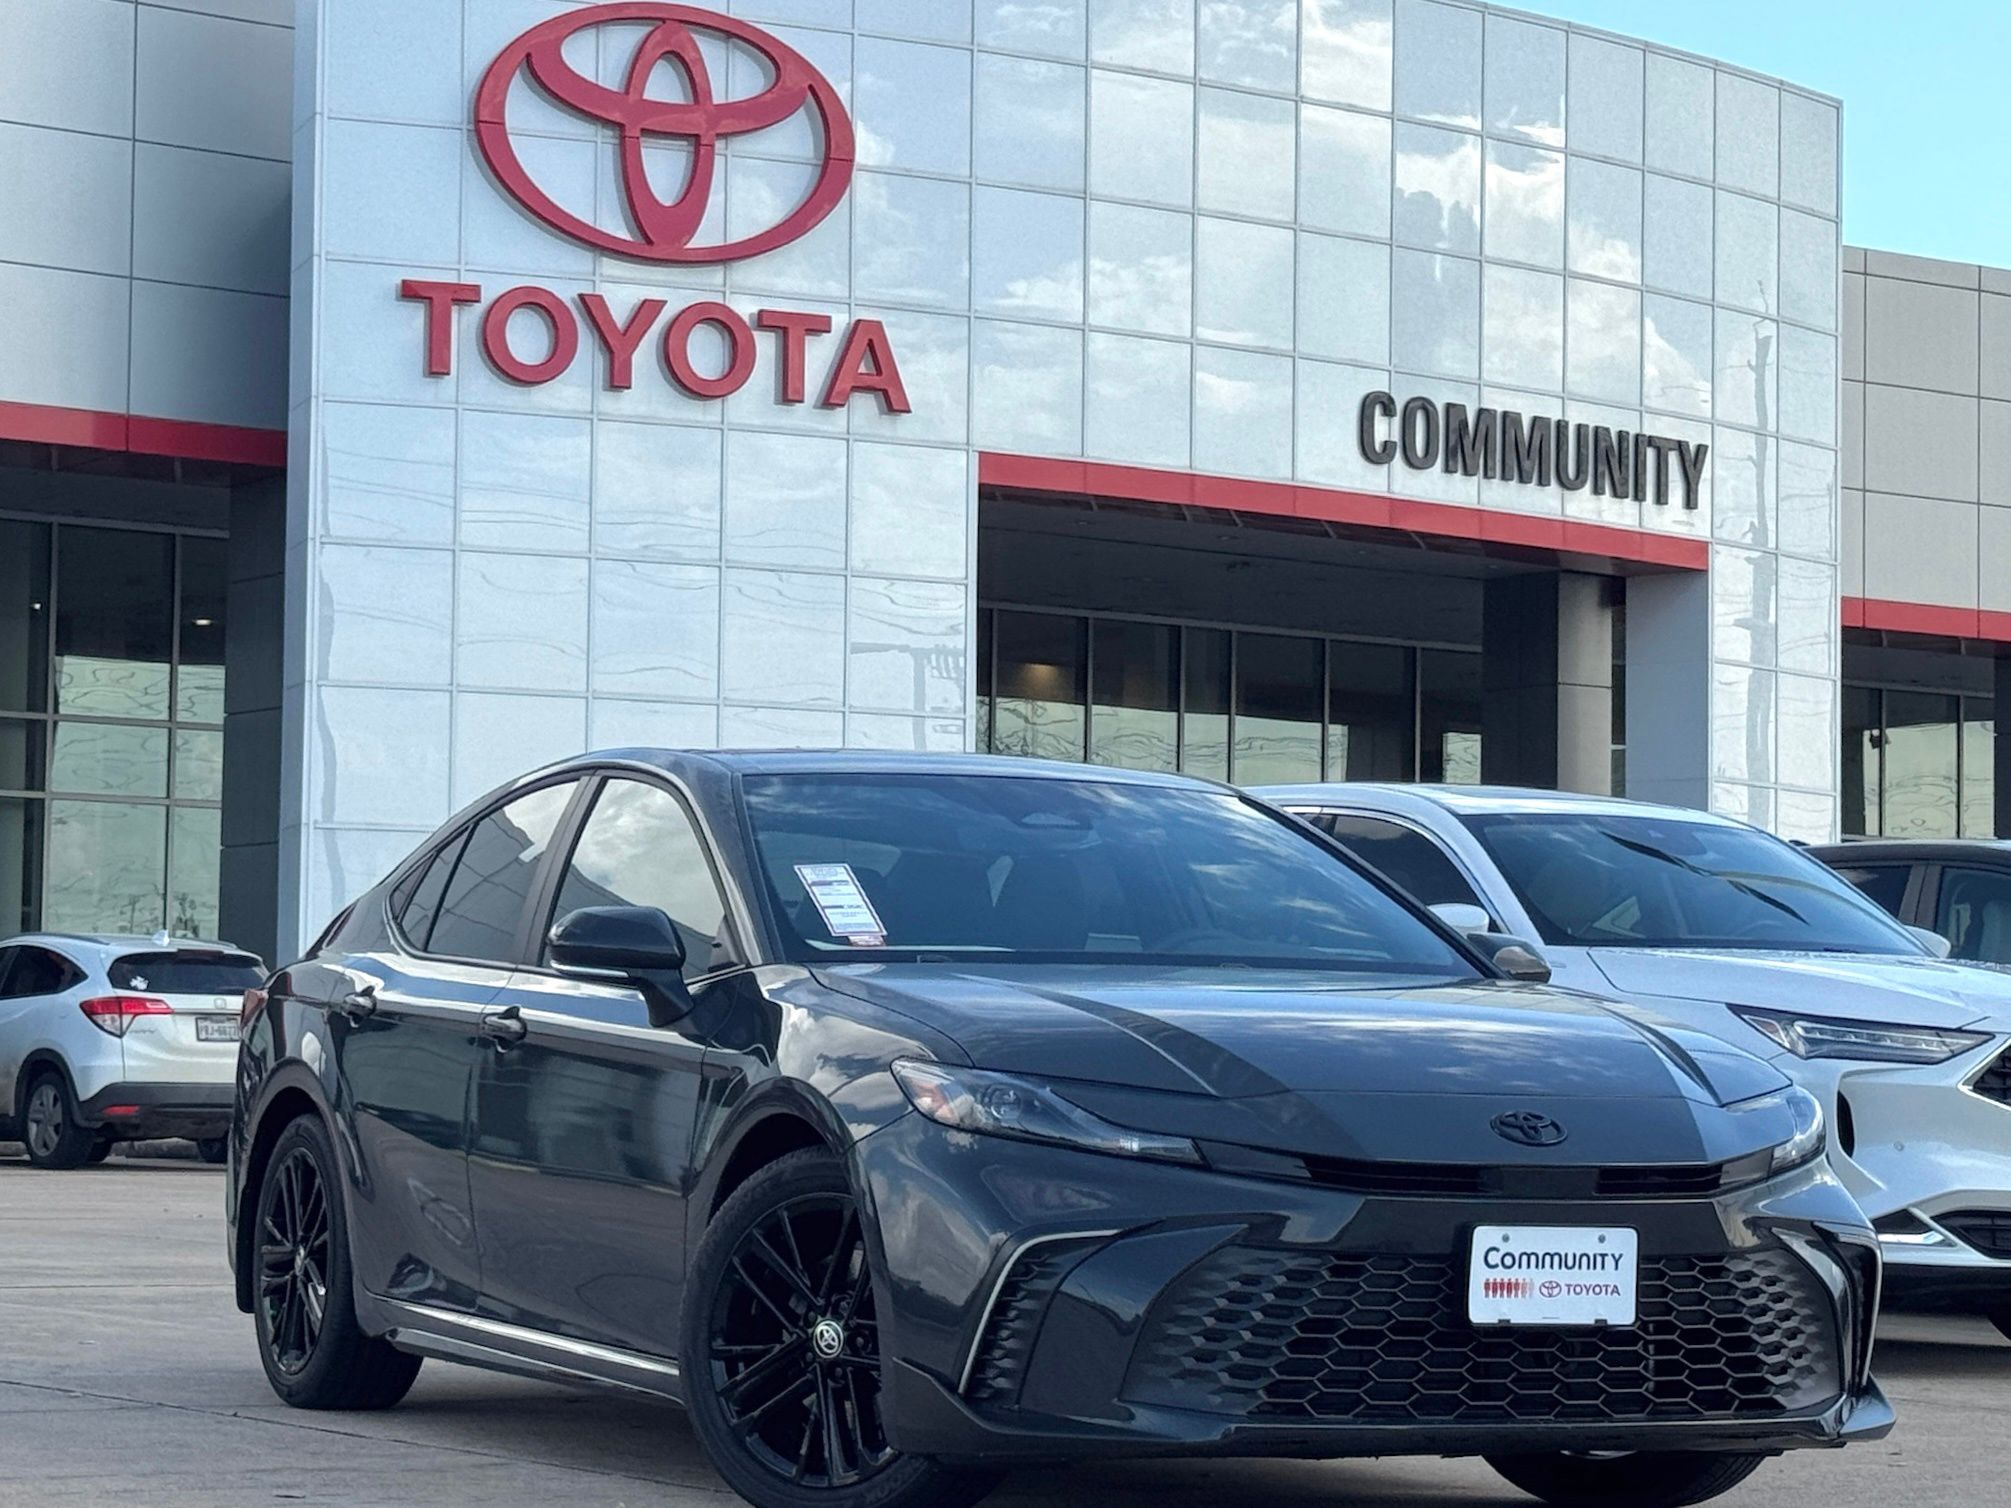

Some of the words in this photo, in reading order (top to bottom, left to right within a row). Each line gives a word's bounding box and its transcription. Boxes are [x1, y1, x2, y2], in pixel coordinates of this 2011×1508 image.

[399, 278, 912, 414] TOYOTA
[1359, 390, 1709, 510] COMMUNITY
[1565, 1283, 1621, 1297] TOYOTA
